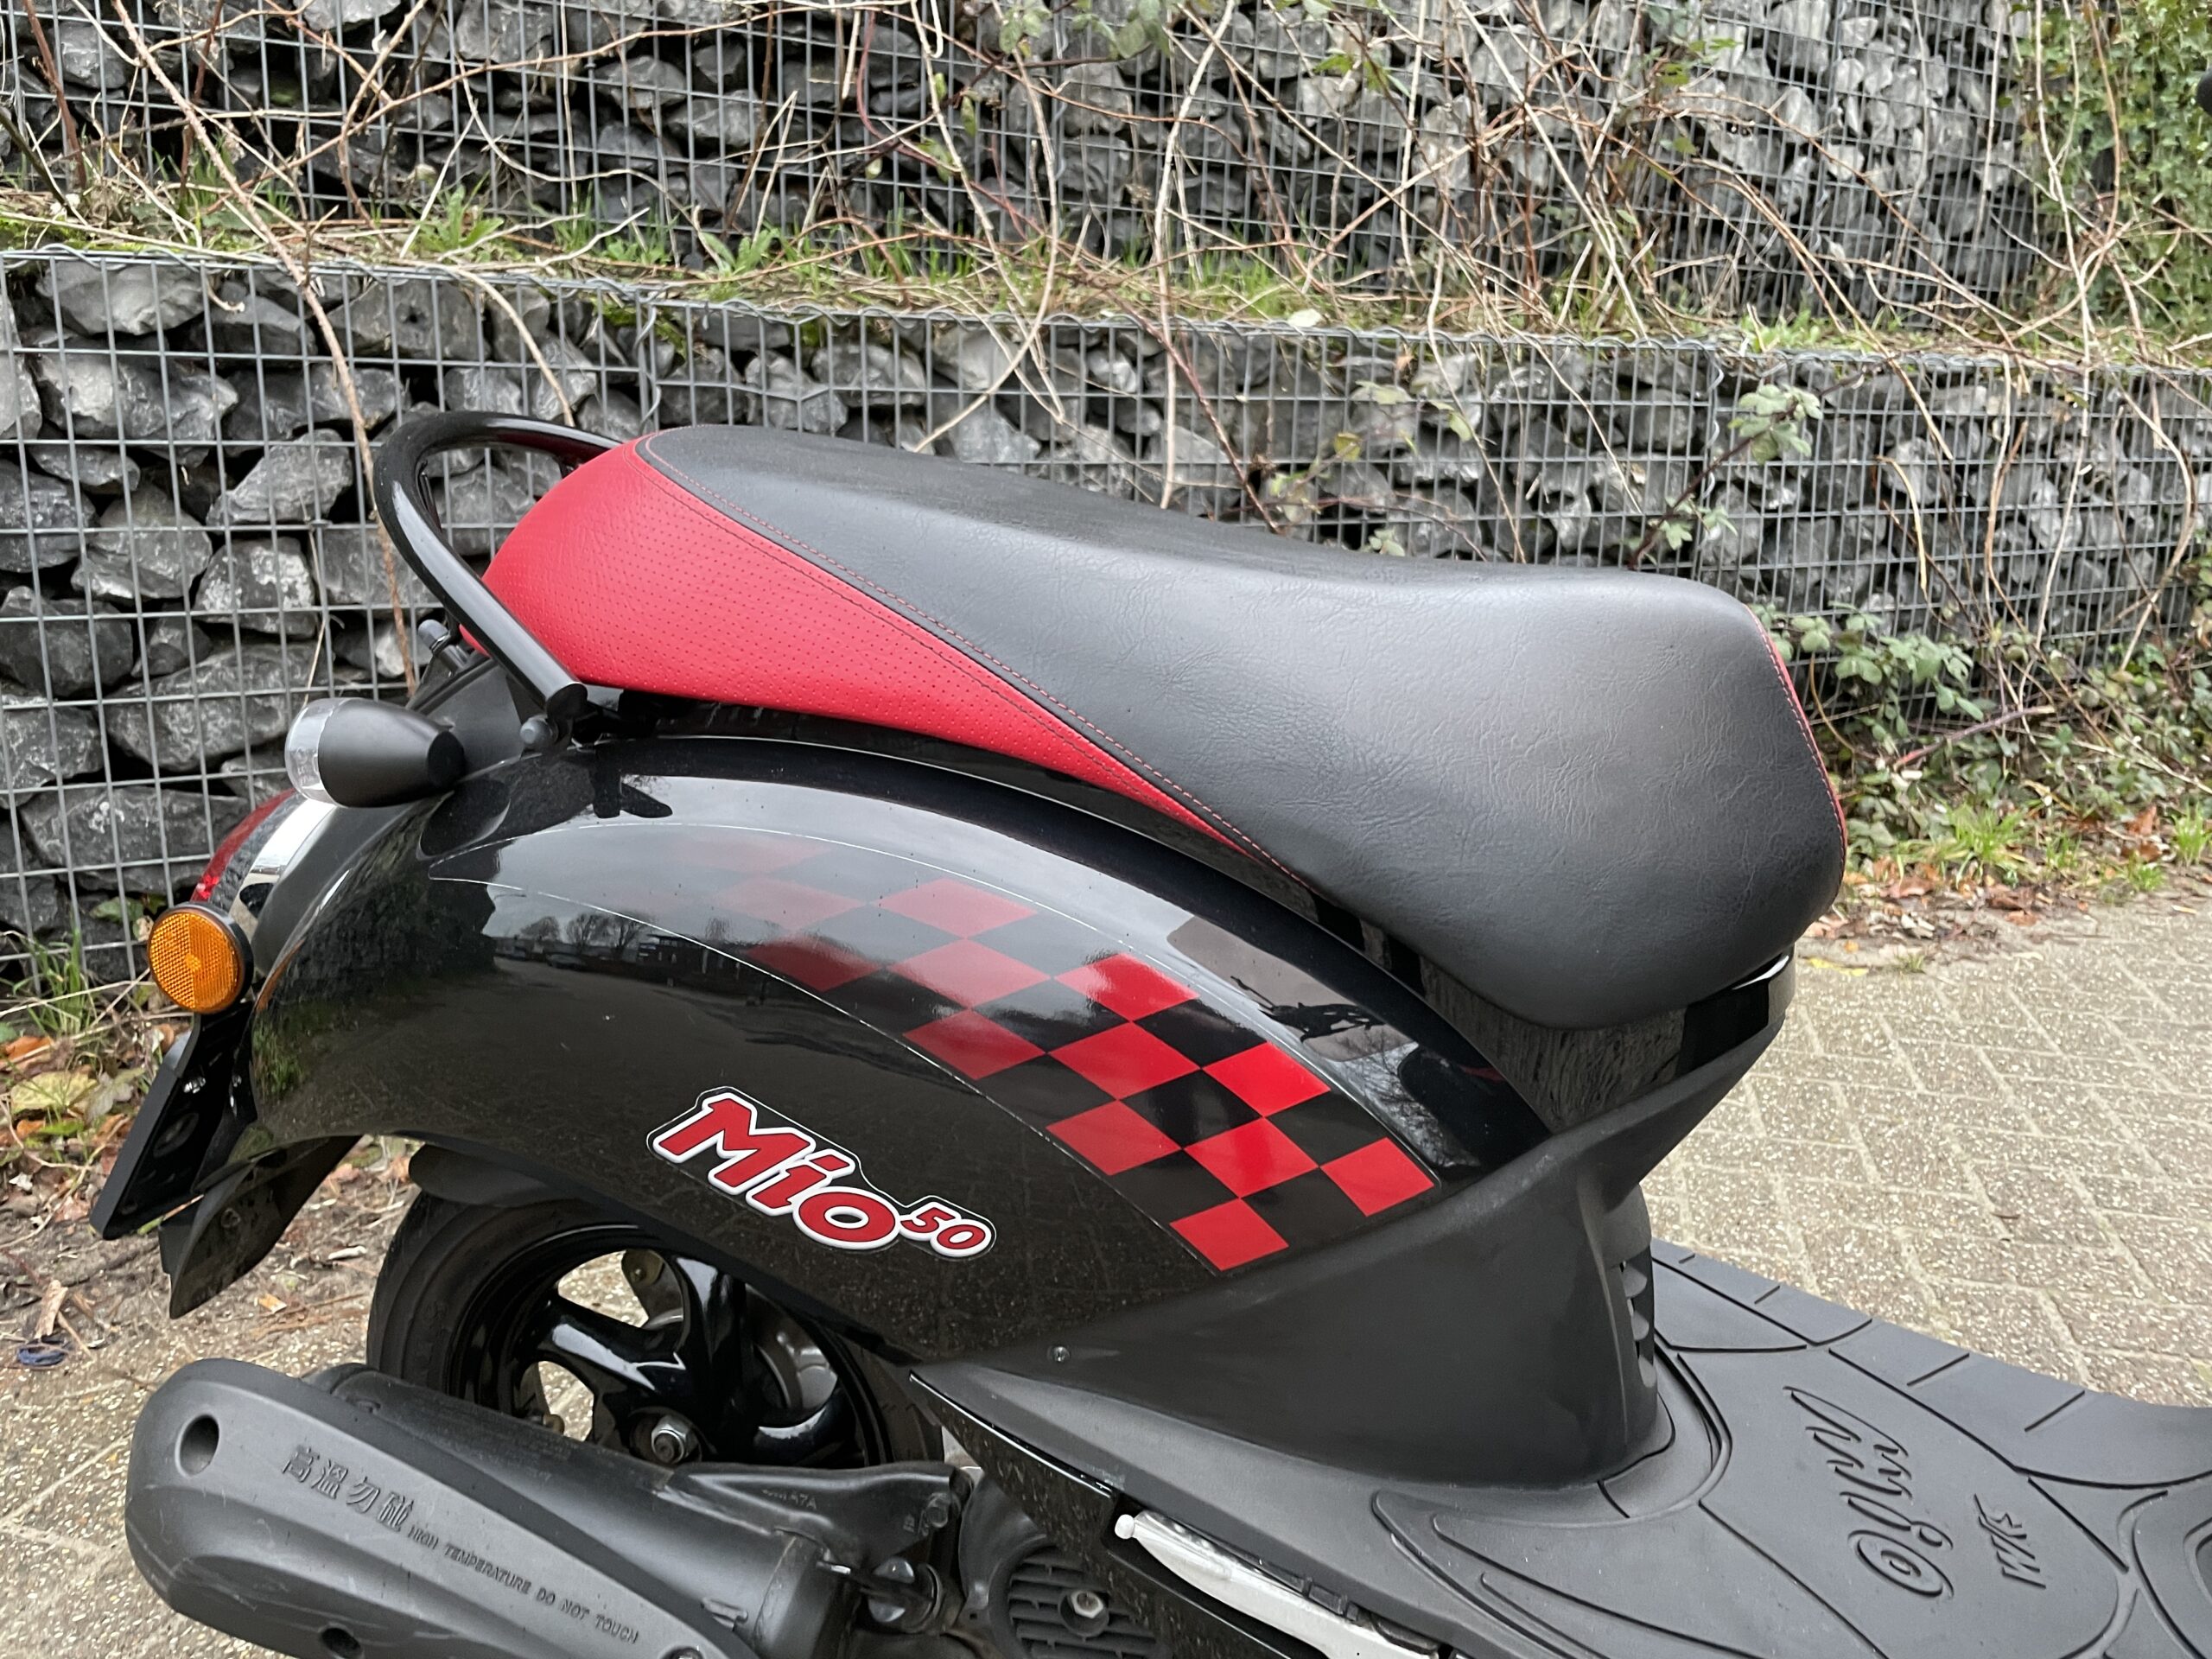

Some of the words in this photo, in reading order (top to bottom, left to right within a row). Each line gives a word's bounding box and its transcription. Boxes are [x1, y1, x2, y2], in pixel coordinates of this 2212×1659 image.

[652, 1092, 898, 1250] Mio
[898, 1201, 993, 1258] 50
[407, 1525, 439, 1549] HIGH
[444, 1542, 532, 1594] TEMPERATURE
[536, 1587, 556, 1606] DO
[562, 1599, 590, 1621] NOT
[595, 1614, 639, 1644] TOUCH
